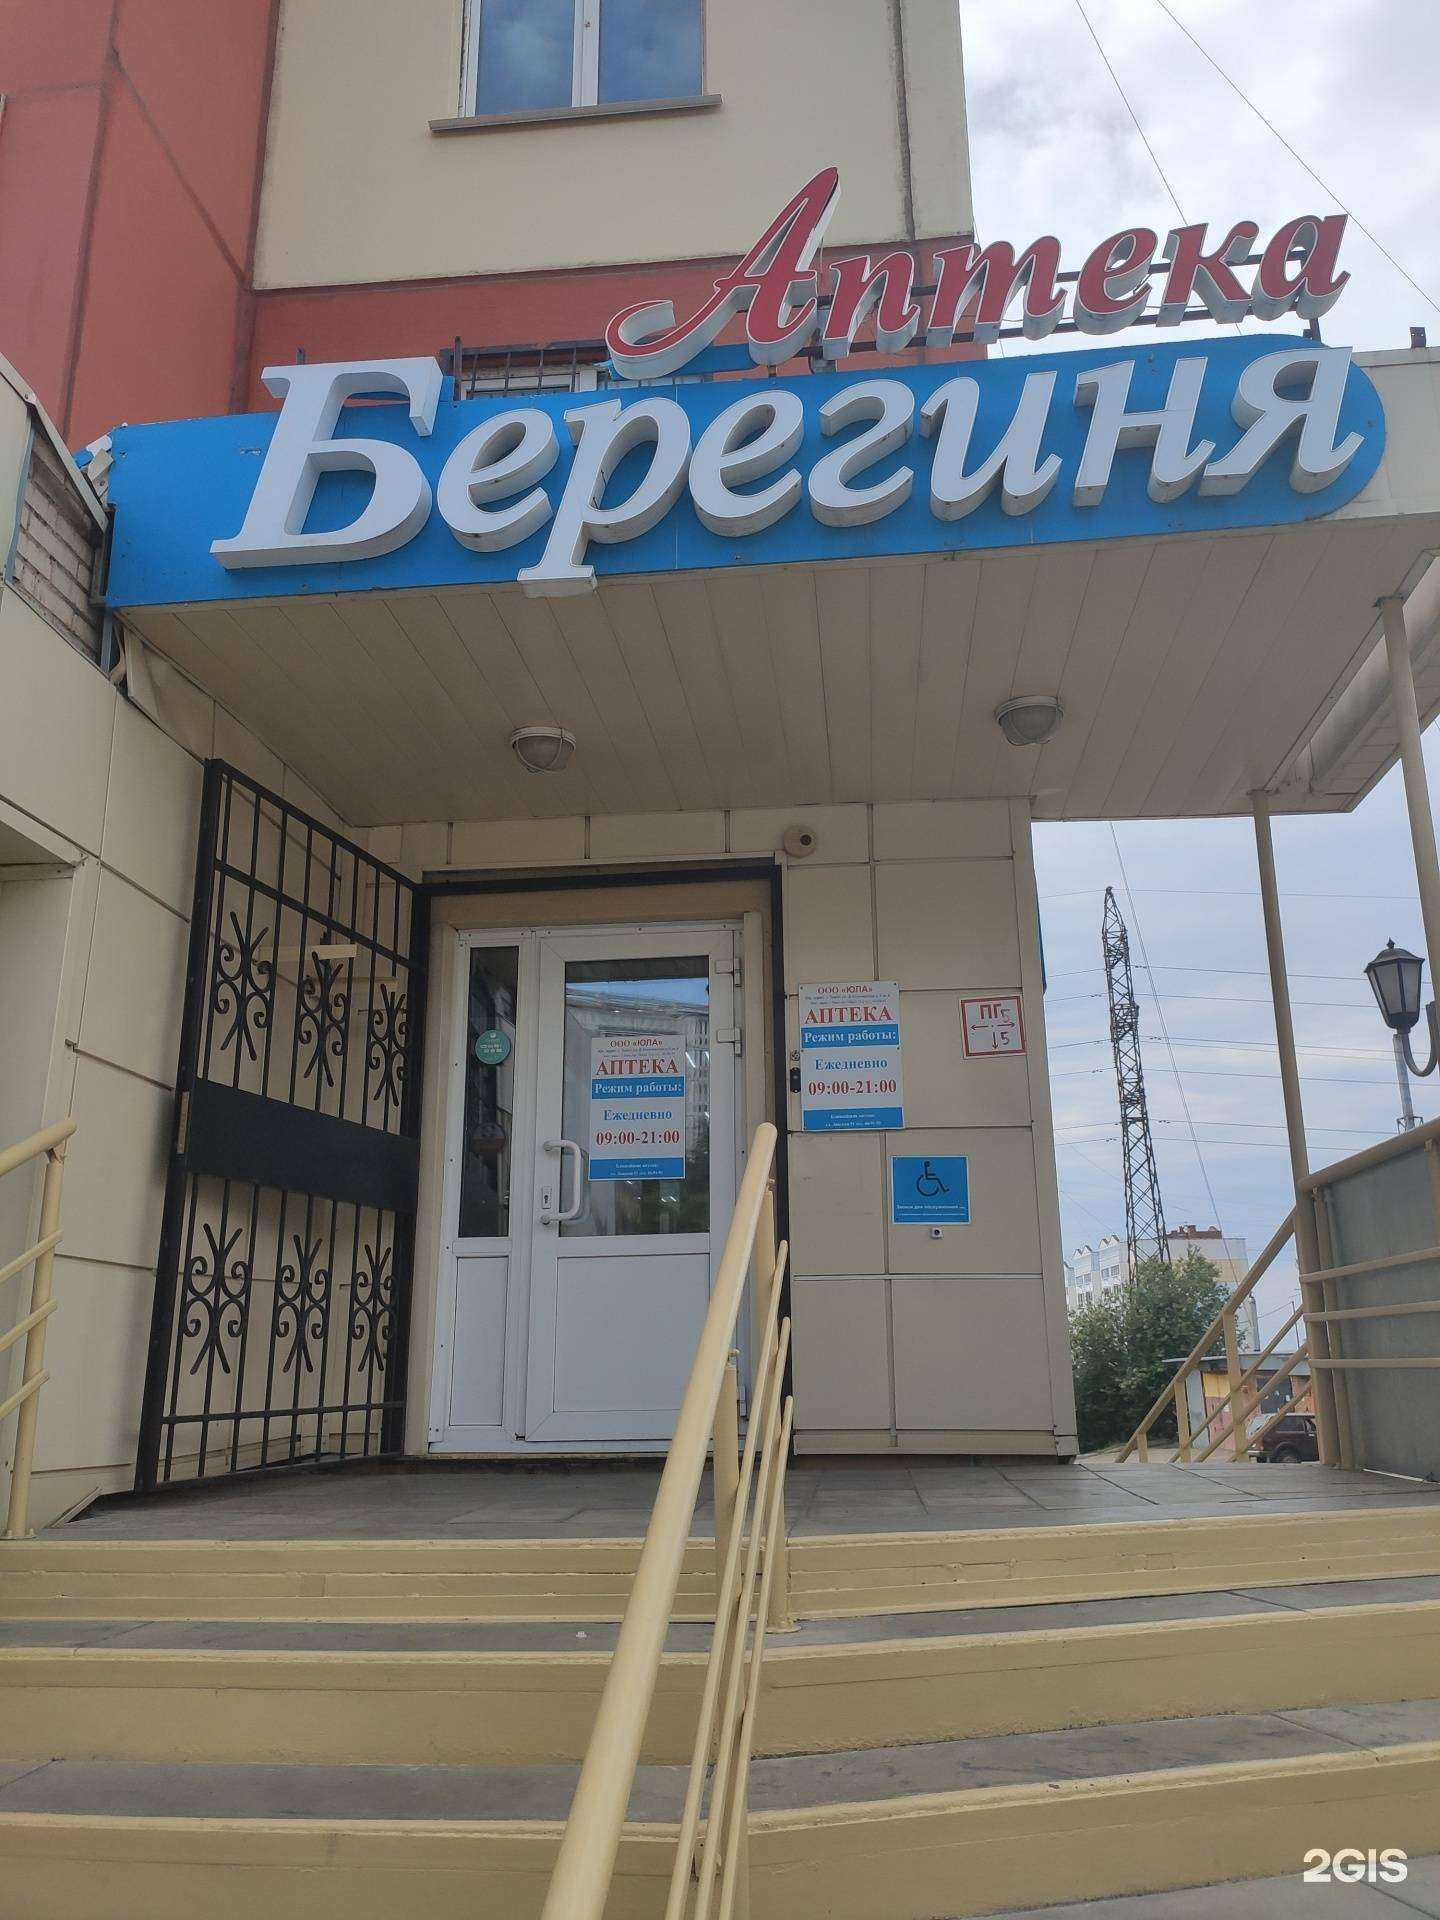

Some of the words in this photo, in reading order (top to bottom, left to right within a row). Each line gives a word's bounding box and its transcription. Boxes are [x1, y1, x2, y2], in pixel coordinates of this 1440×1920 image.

[605, 166, 1350, 378] Аптека
[210, 346, 1366, 596] Берегиня
[817, 986, 839, 995] ООО
[804, 1006, 894, 1024] АПТЕКА
[980, 1003, 1001, 1019] ПГ
[610, 1039, 631, 1048] ООО
[804, 1032, 844, 1043] Режим
[848, 1030, 896, 1043] работы:
[596, 1058, 679, 1076] АПТЕКА
[815, 1059, 888, 1070] Ежедневно
[595, 1083, 632, 1094] Режим
[636, 1081, 681, 1095] работы:
[808, 1080, 897, 1096] 09:00-21:00
[604, 1109, 672, 1120] Ежедневно
[596, 1130, 680, 1145] 09:00-21:00
